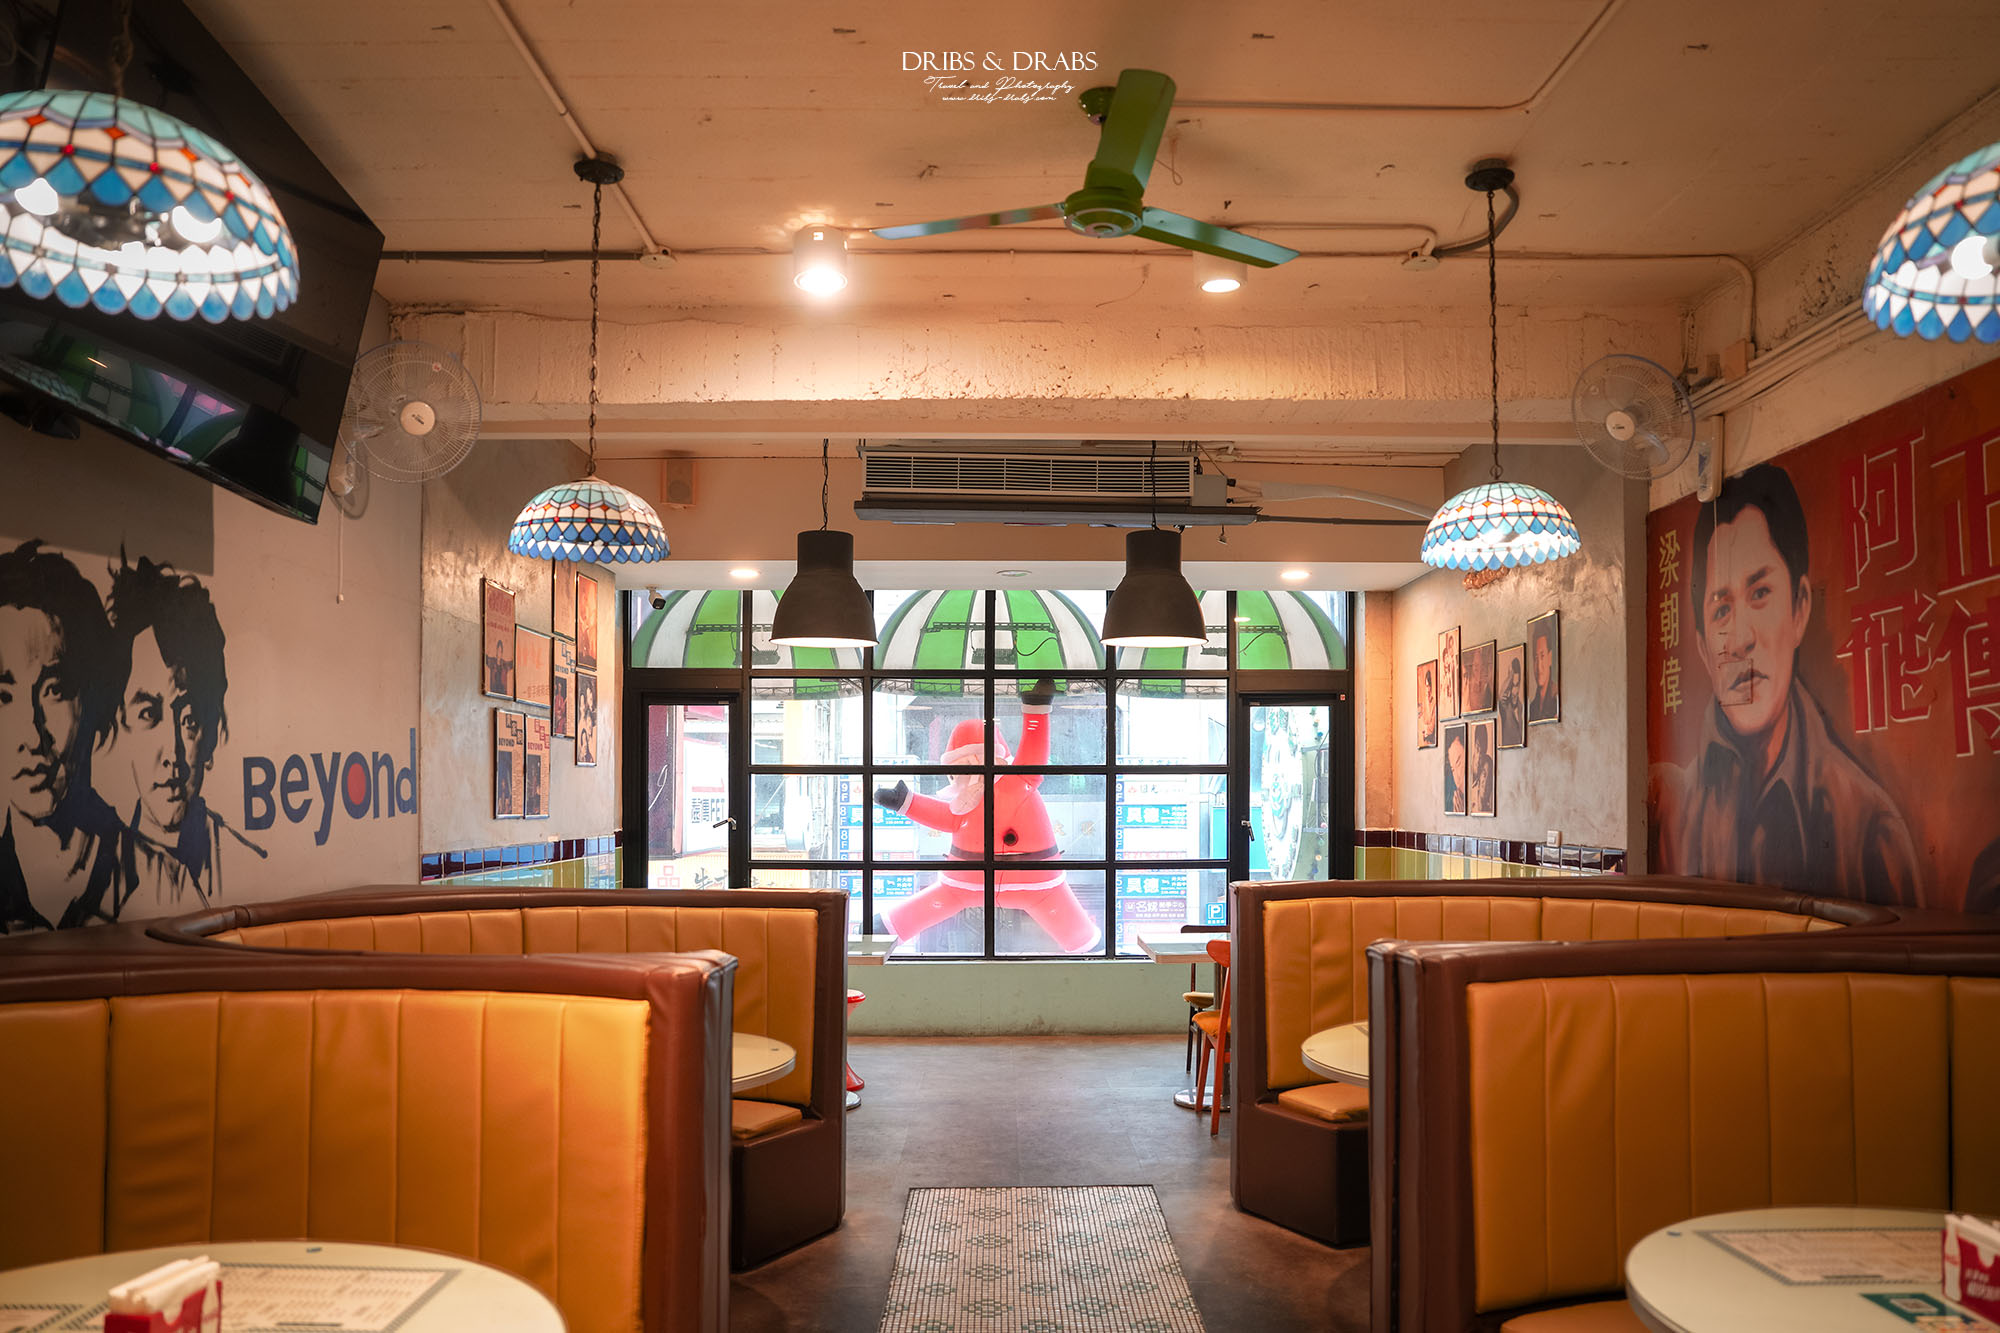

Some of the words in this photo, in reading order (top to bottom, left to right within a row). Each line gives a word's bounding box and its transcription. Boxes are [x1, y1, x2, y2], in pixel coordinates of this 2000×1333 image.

[1659, 529, 1683, 715] 梁朝偉
[498, 737, 515, 748] BEYOND
[527, 741, 543, 752] BEYOND
[243, 727, 417, 846] Beyond
[1210, 905, 1220, 918] P
